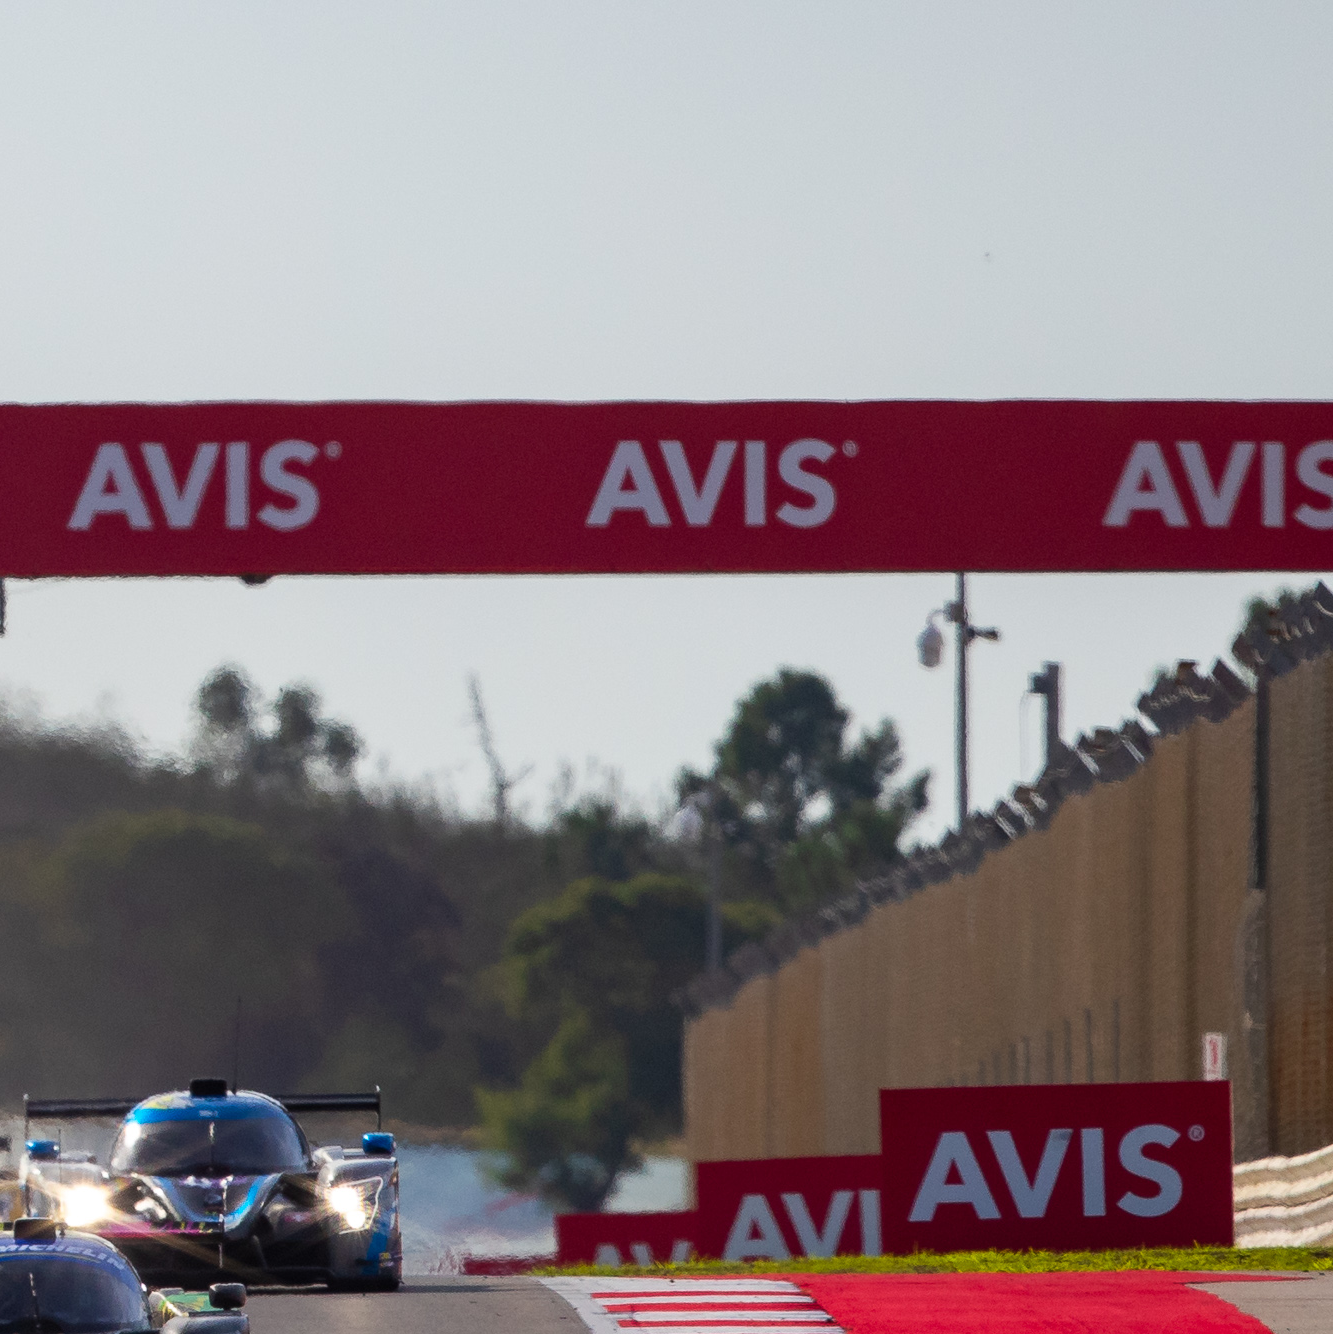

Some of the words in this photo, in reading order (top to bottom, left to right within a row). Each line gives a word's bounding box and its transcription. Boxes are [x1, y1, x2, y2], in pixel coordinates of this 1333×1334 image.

[68, 440, 320, 531] AVIS
[586, 438, 836, 528] AVIS
[908, 1124, 1183, 1222] AVIS
[721, 1188, 882, 1262] AVI
